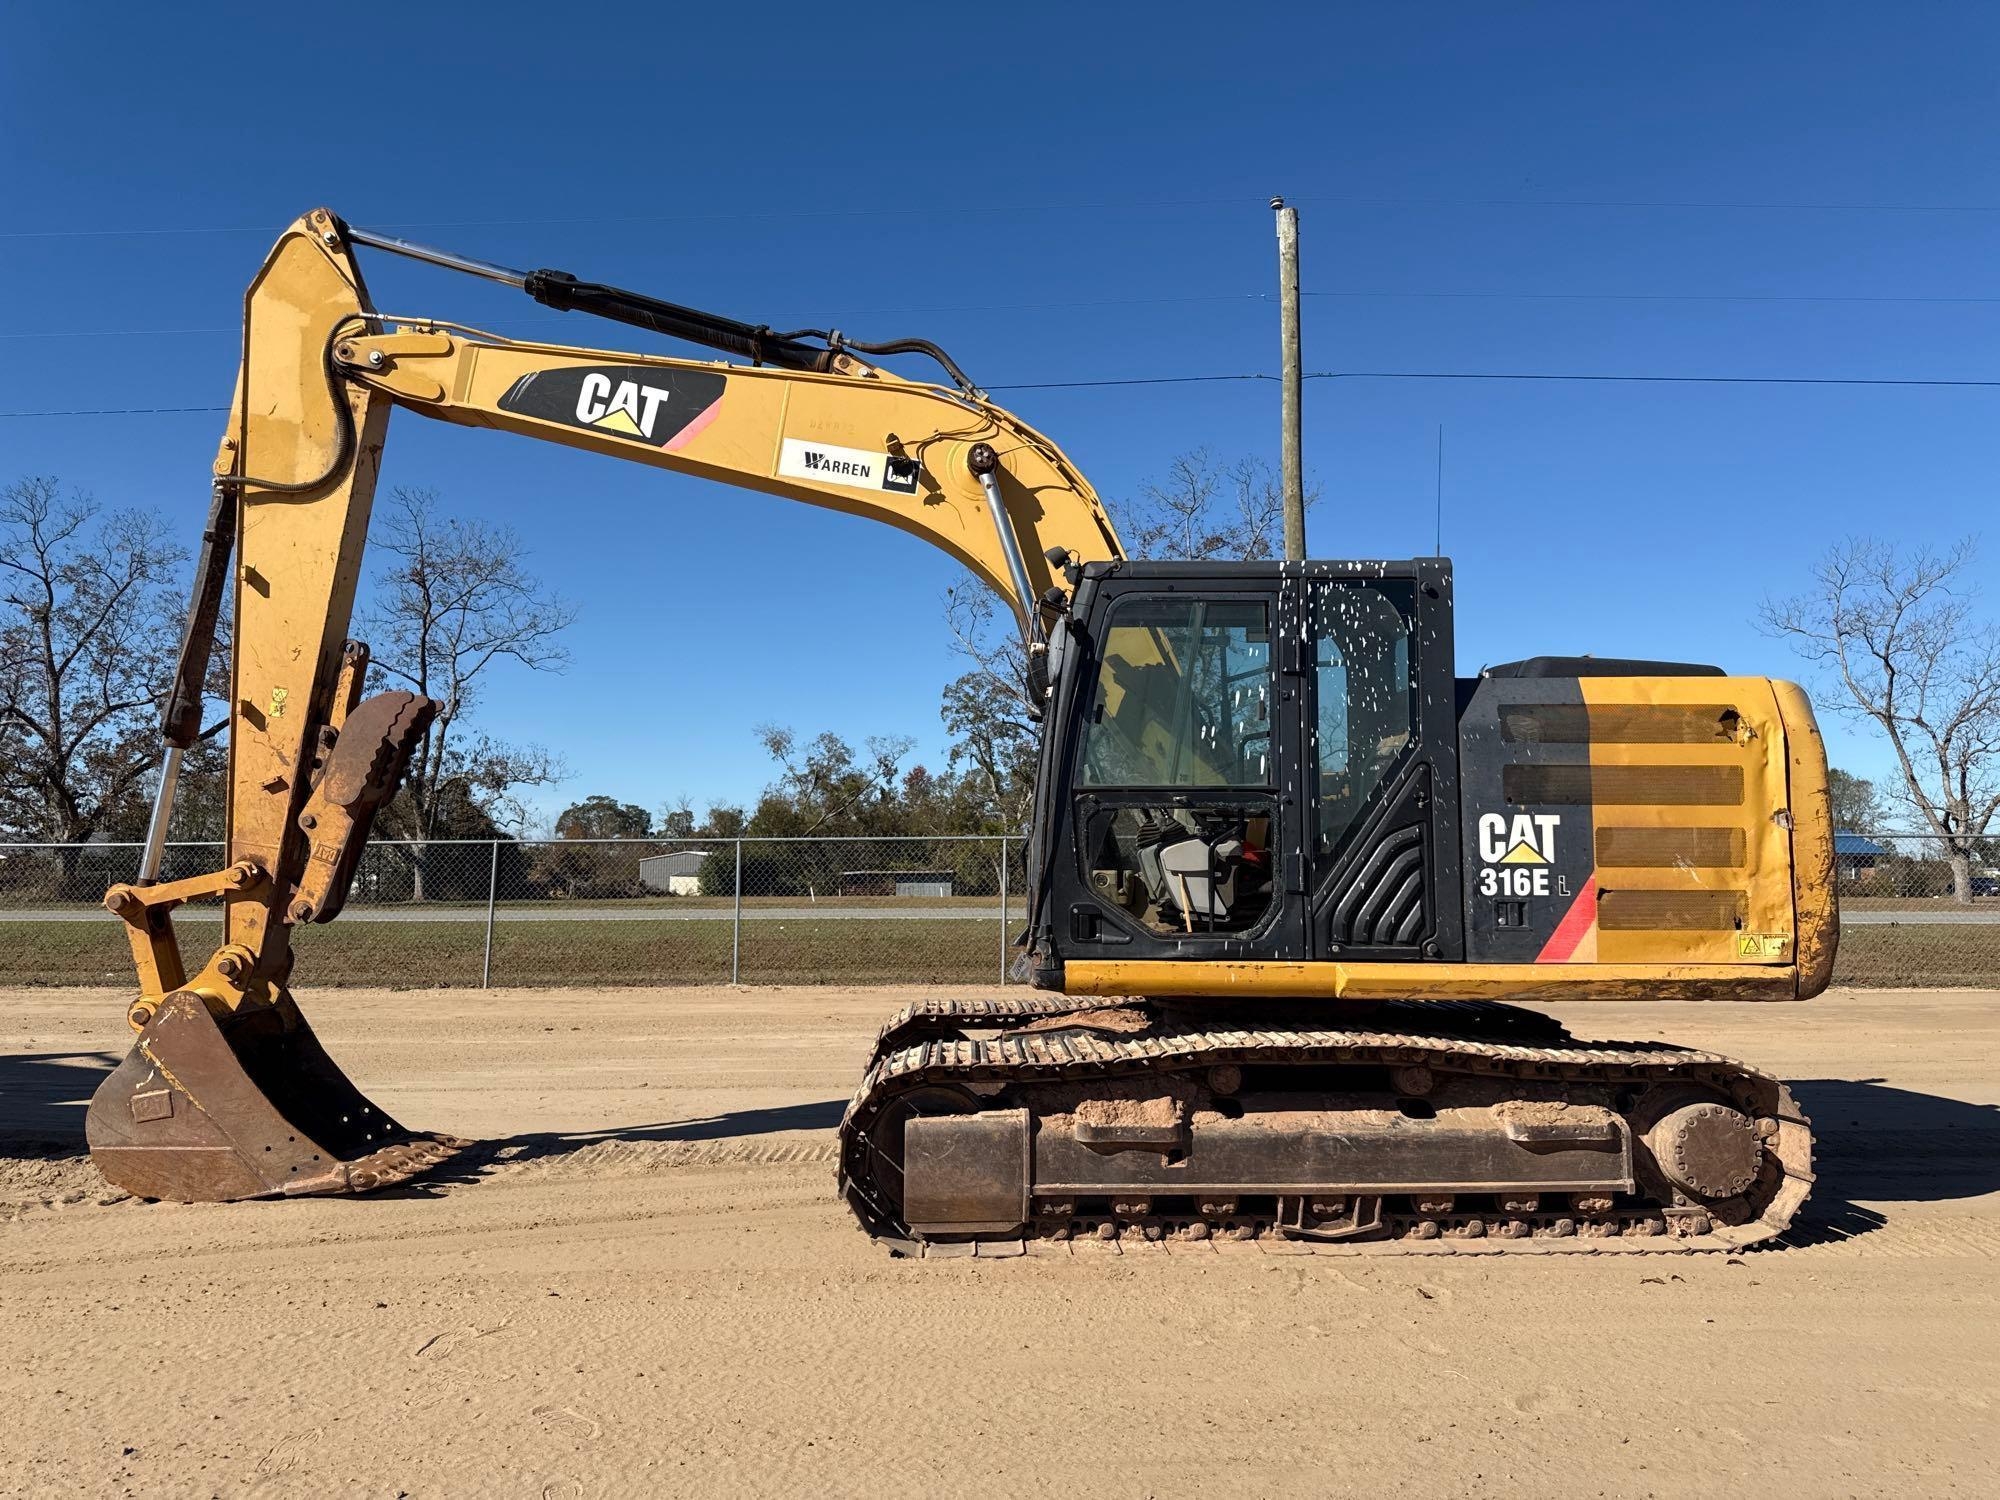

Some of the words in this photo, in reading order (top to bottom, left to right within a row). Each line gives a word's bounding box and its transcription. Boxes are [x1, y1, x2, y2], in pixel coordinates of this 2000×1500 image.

[576, 373, 669, 439] CAT
[805, 451, 870, 478] WARREN
[1479, 813, 1560, 864] CAT
[1480, 868, 1550, 896] 316E
[1559, 875, 1571, 896] L
